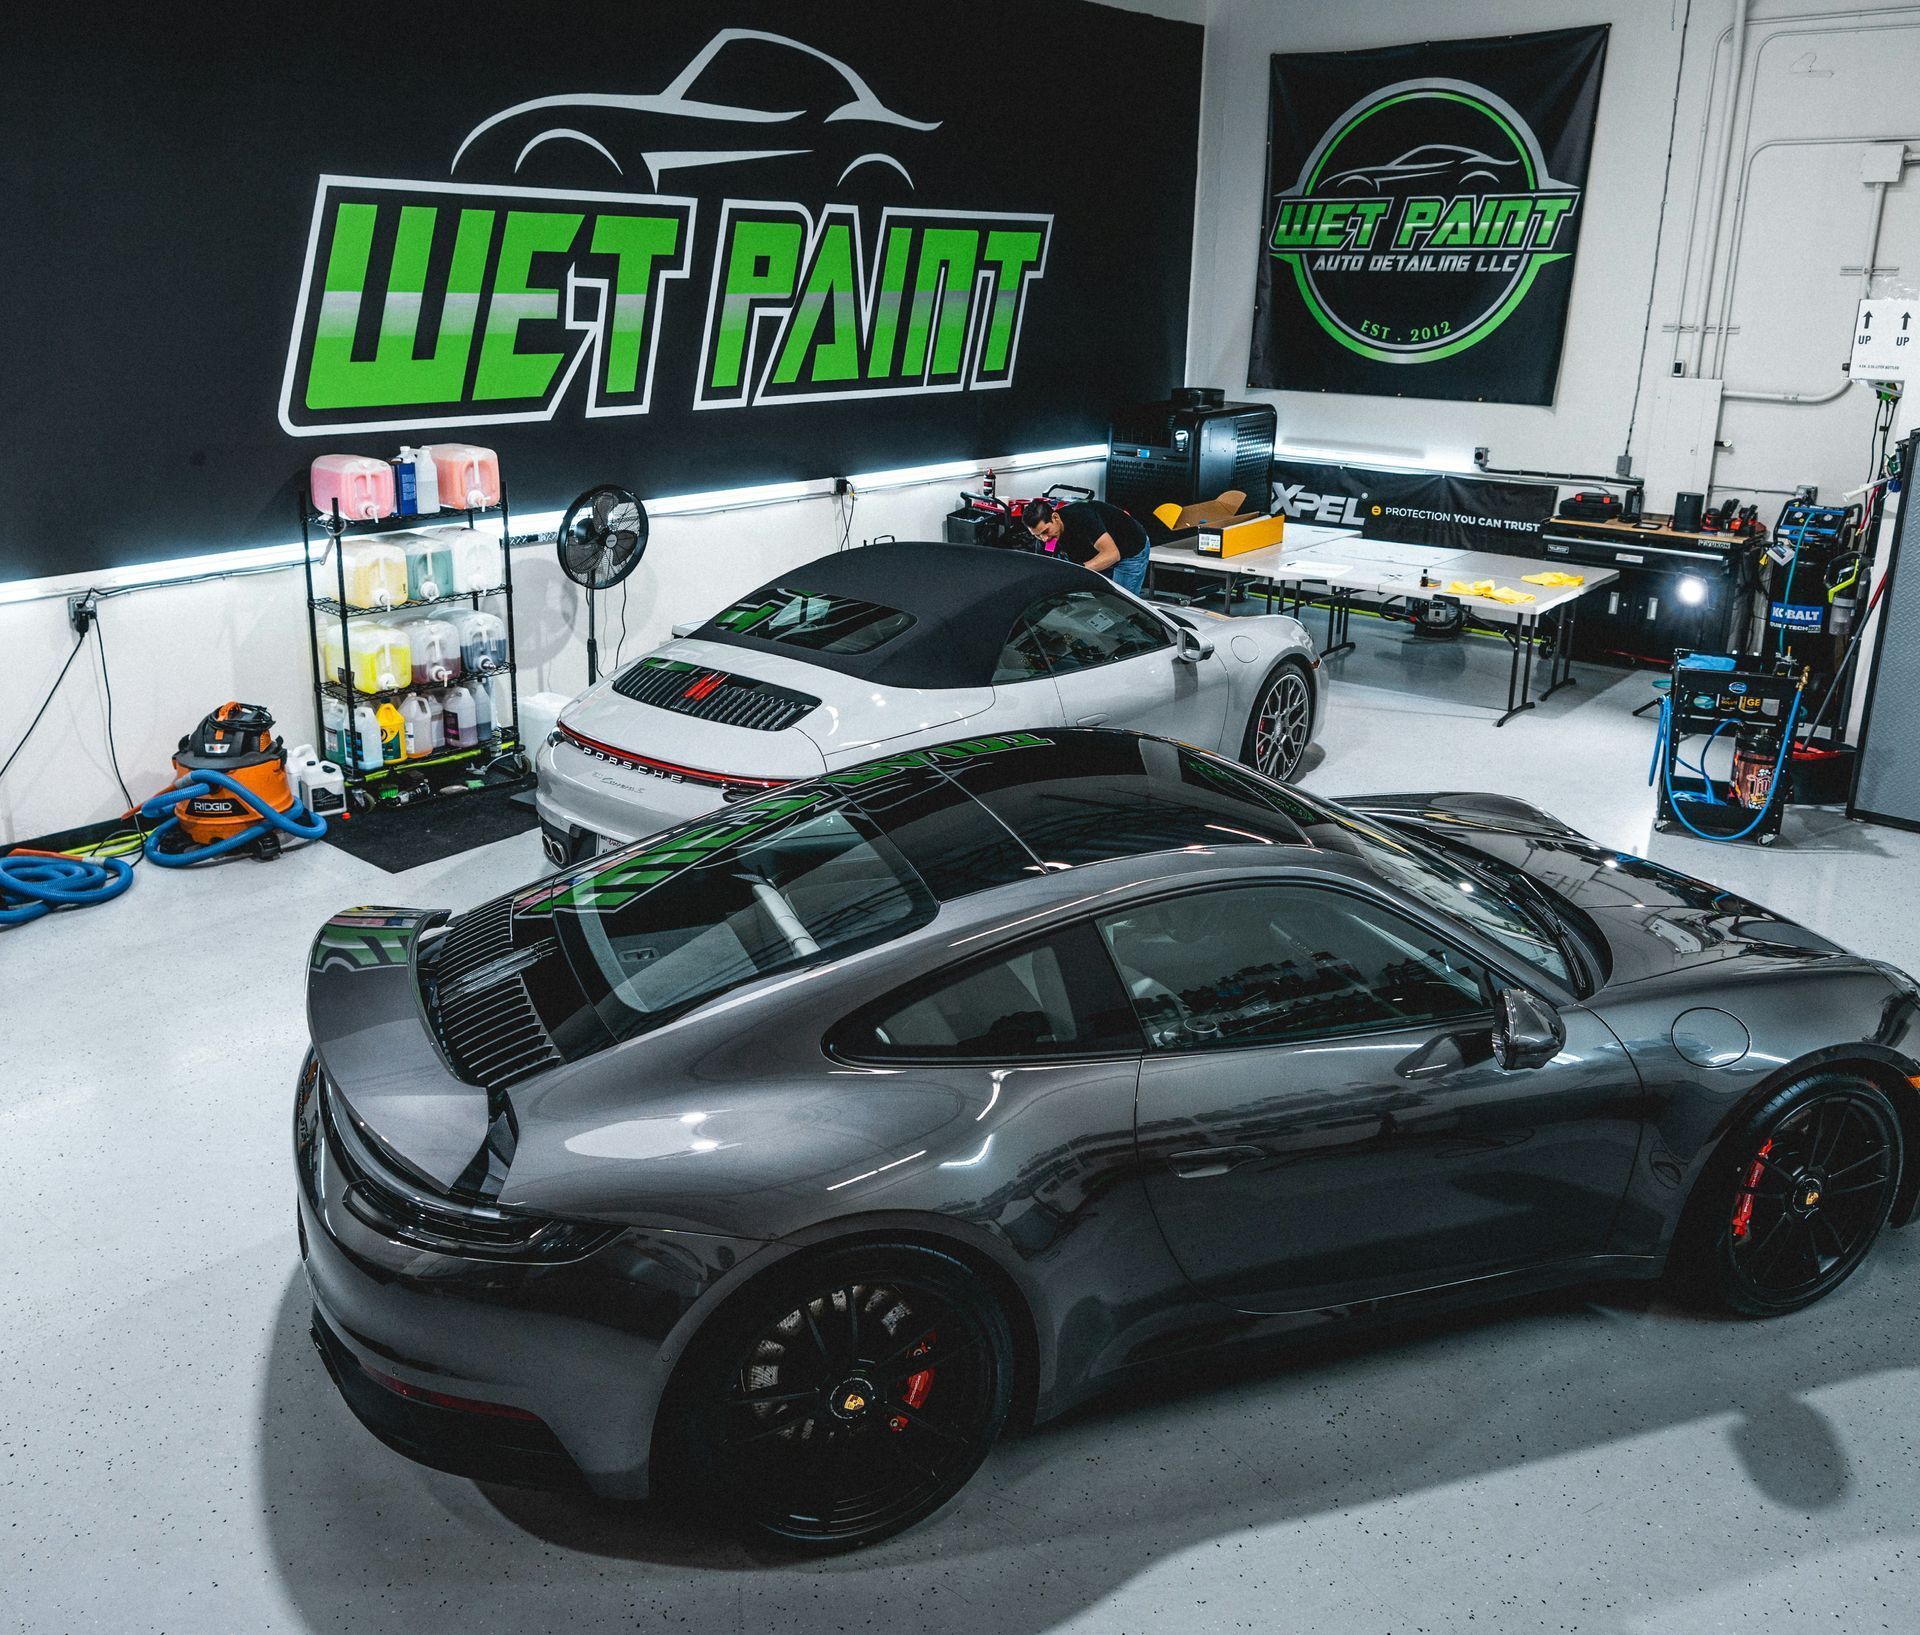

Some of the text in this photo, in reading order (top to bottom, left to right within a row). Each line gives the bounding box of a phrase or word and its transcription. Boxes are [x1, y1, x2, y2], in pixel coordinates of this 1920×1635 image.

[1273, 198, 1573, 246] WET PAINT
[1312, 254, 1517, 272] AUTO DETAILING LLC
[304, 202, 1043, 411] WET PAINT
[1410, 320, 1452, 342] 2012
[1858, 335, 1872, 345] UP
[1896, 336, 1910, 347] UP
[1270, 481, 1365, 526] XPEL
[1385, 506, 1541, 533] PROTECTION YOU CAN TRUST
[583, 746, 683, 784] PORSCHE
[194, 801, 233, 812] RIDGID
